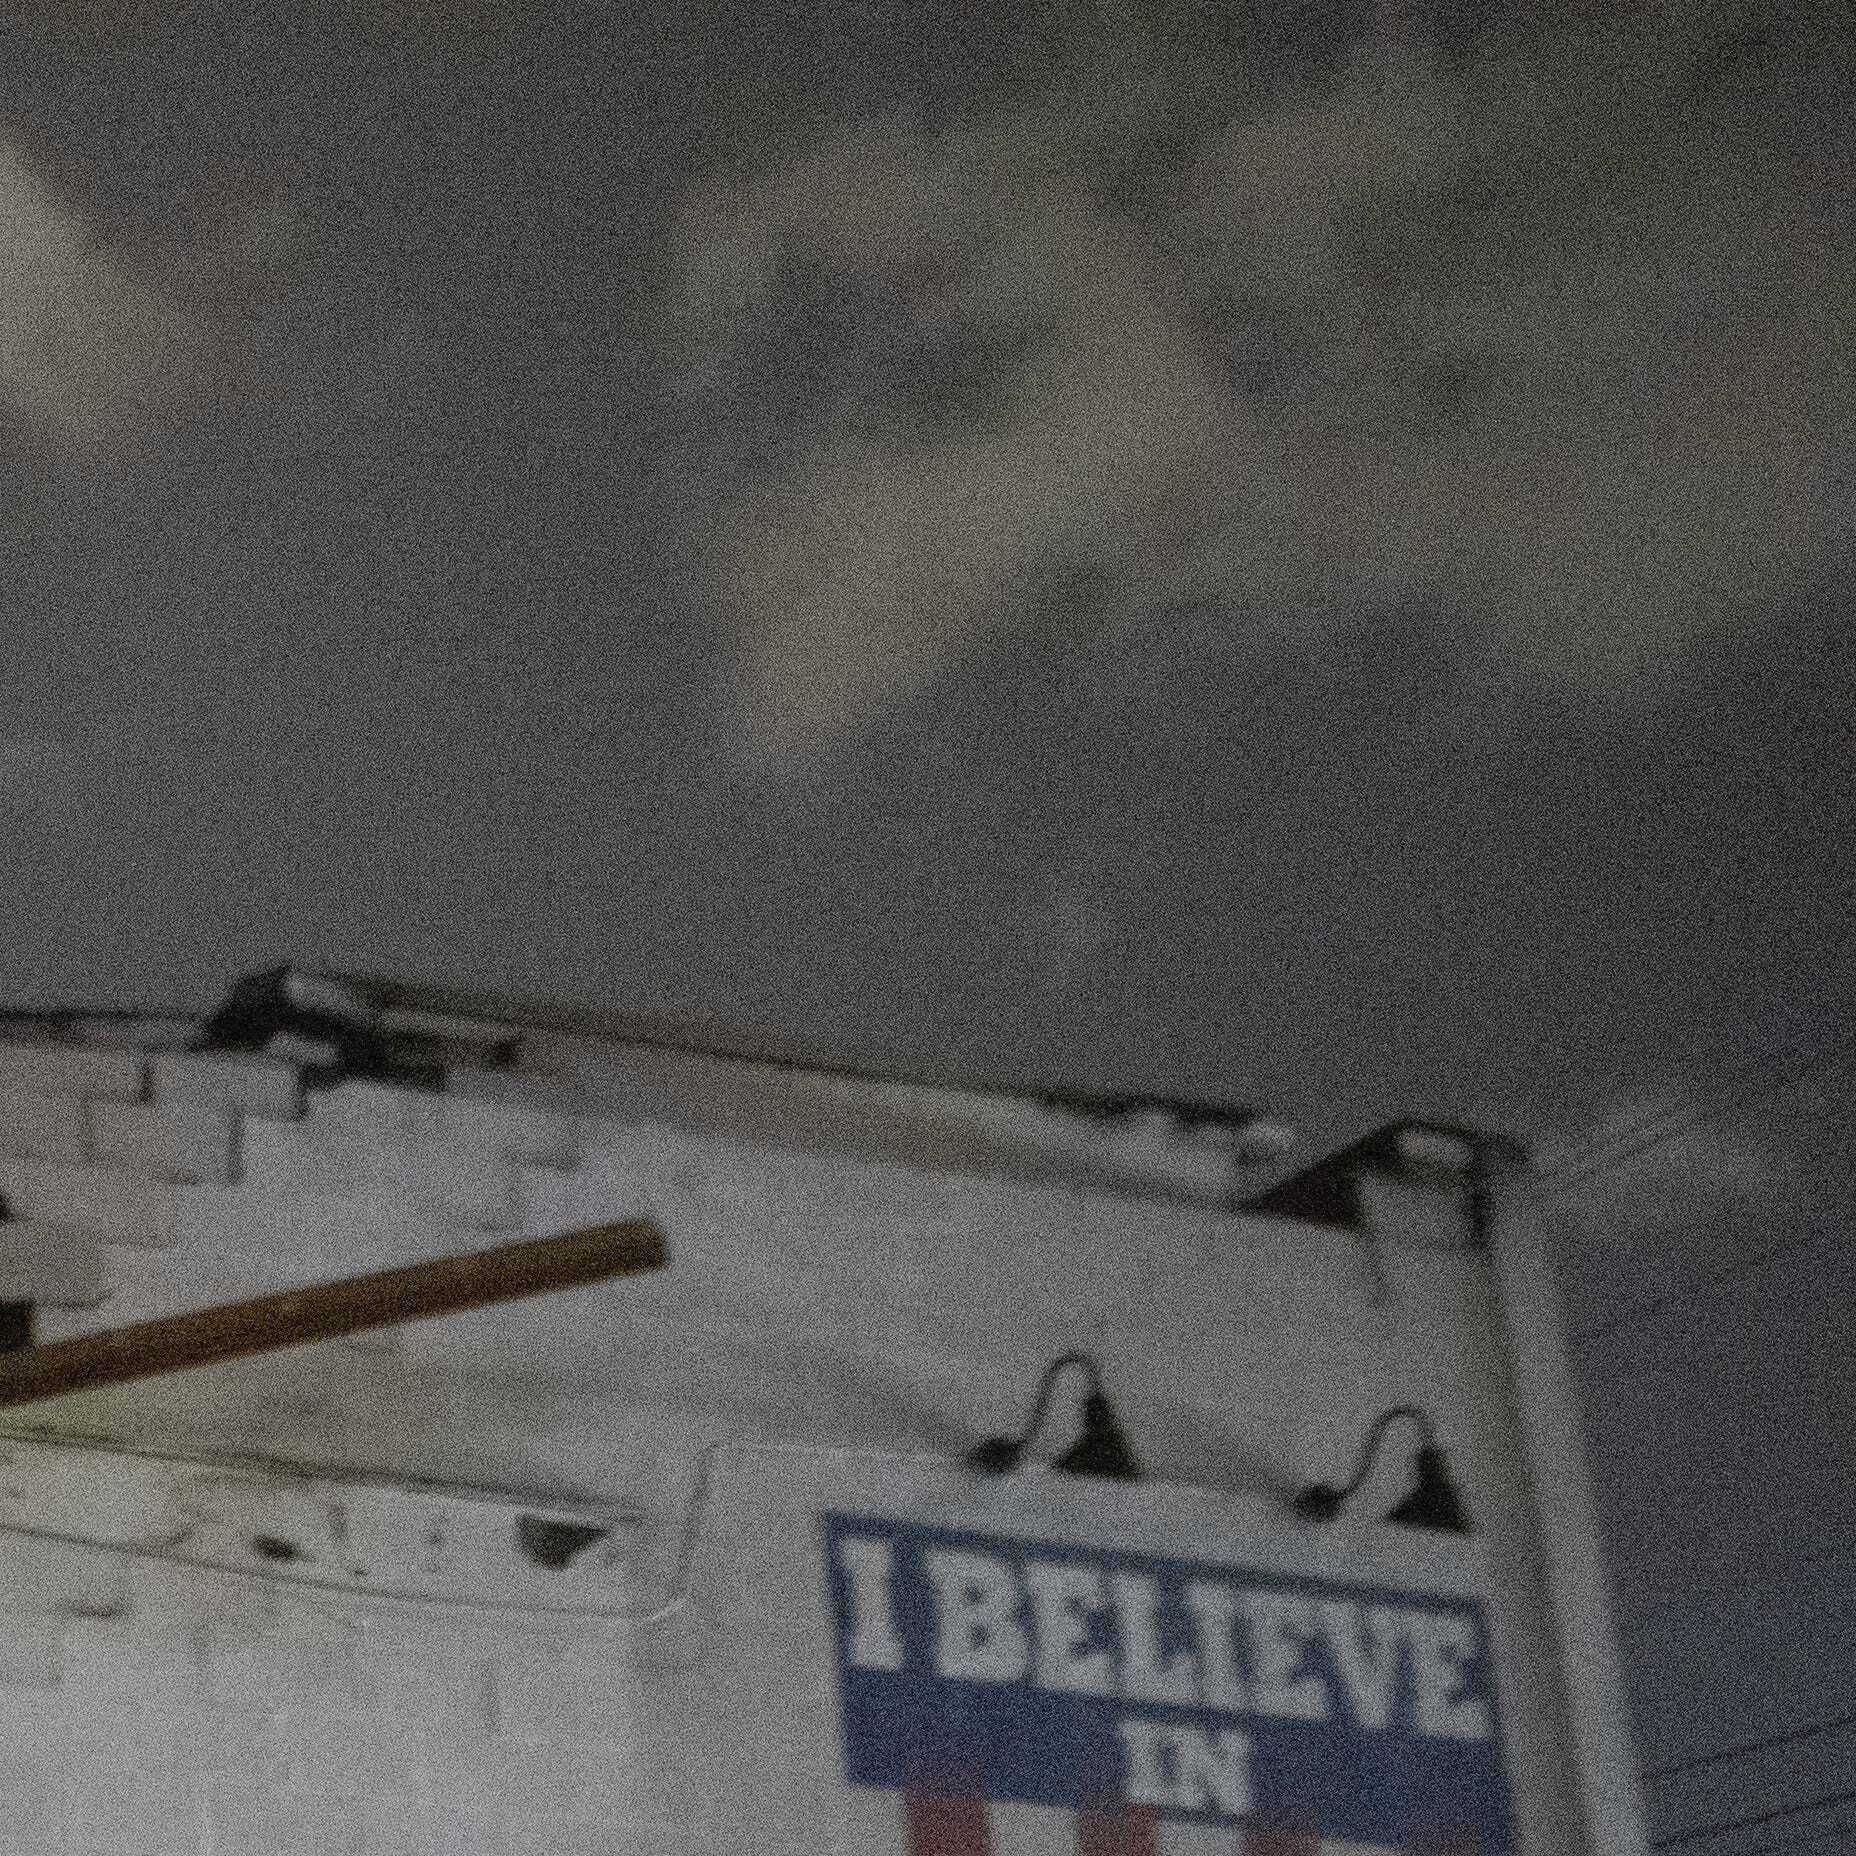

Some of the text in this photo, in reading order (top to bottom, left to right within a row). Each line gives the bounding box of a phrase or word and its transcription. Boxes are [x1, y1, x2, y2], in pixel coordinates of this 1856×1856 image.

[839, 1536, 1489, 1741] I BELIEVE
[1117, 1719, 1254, 1814] IN
